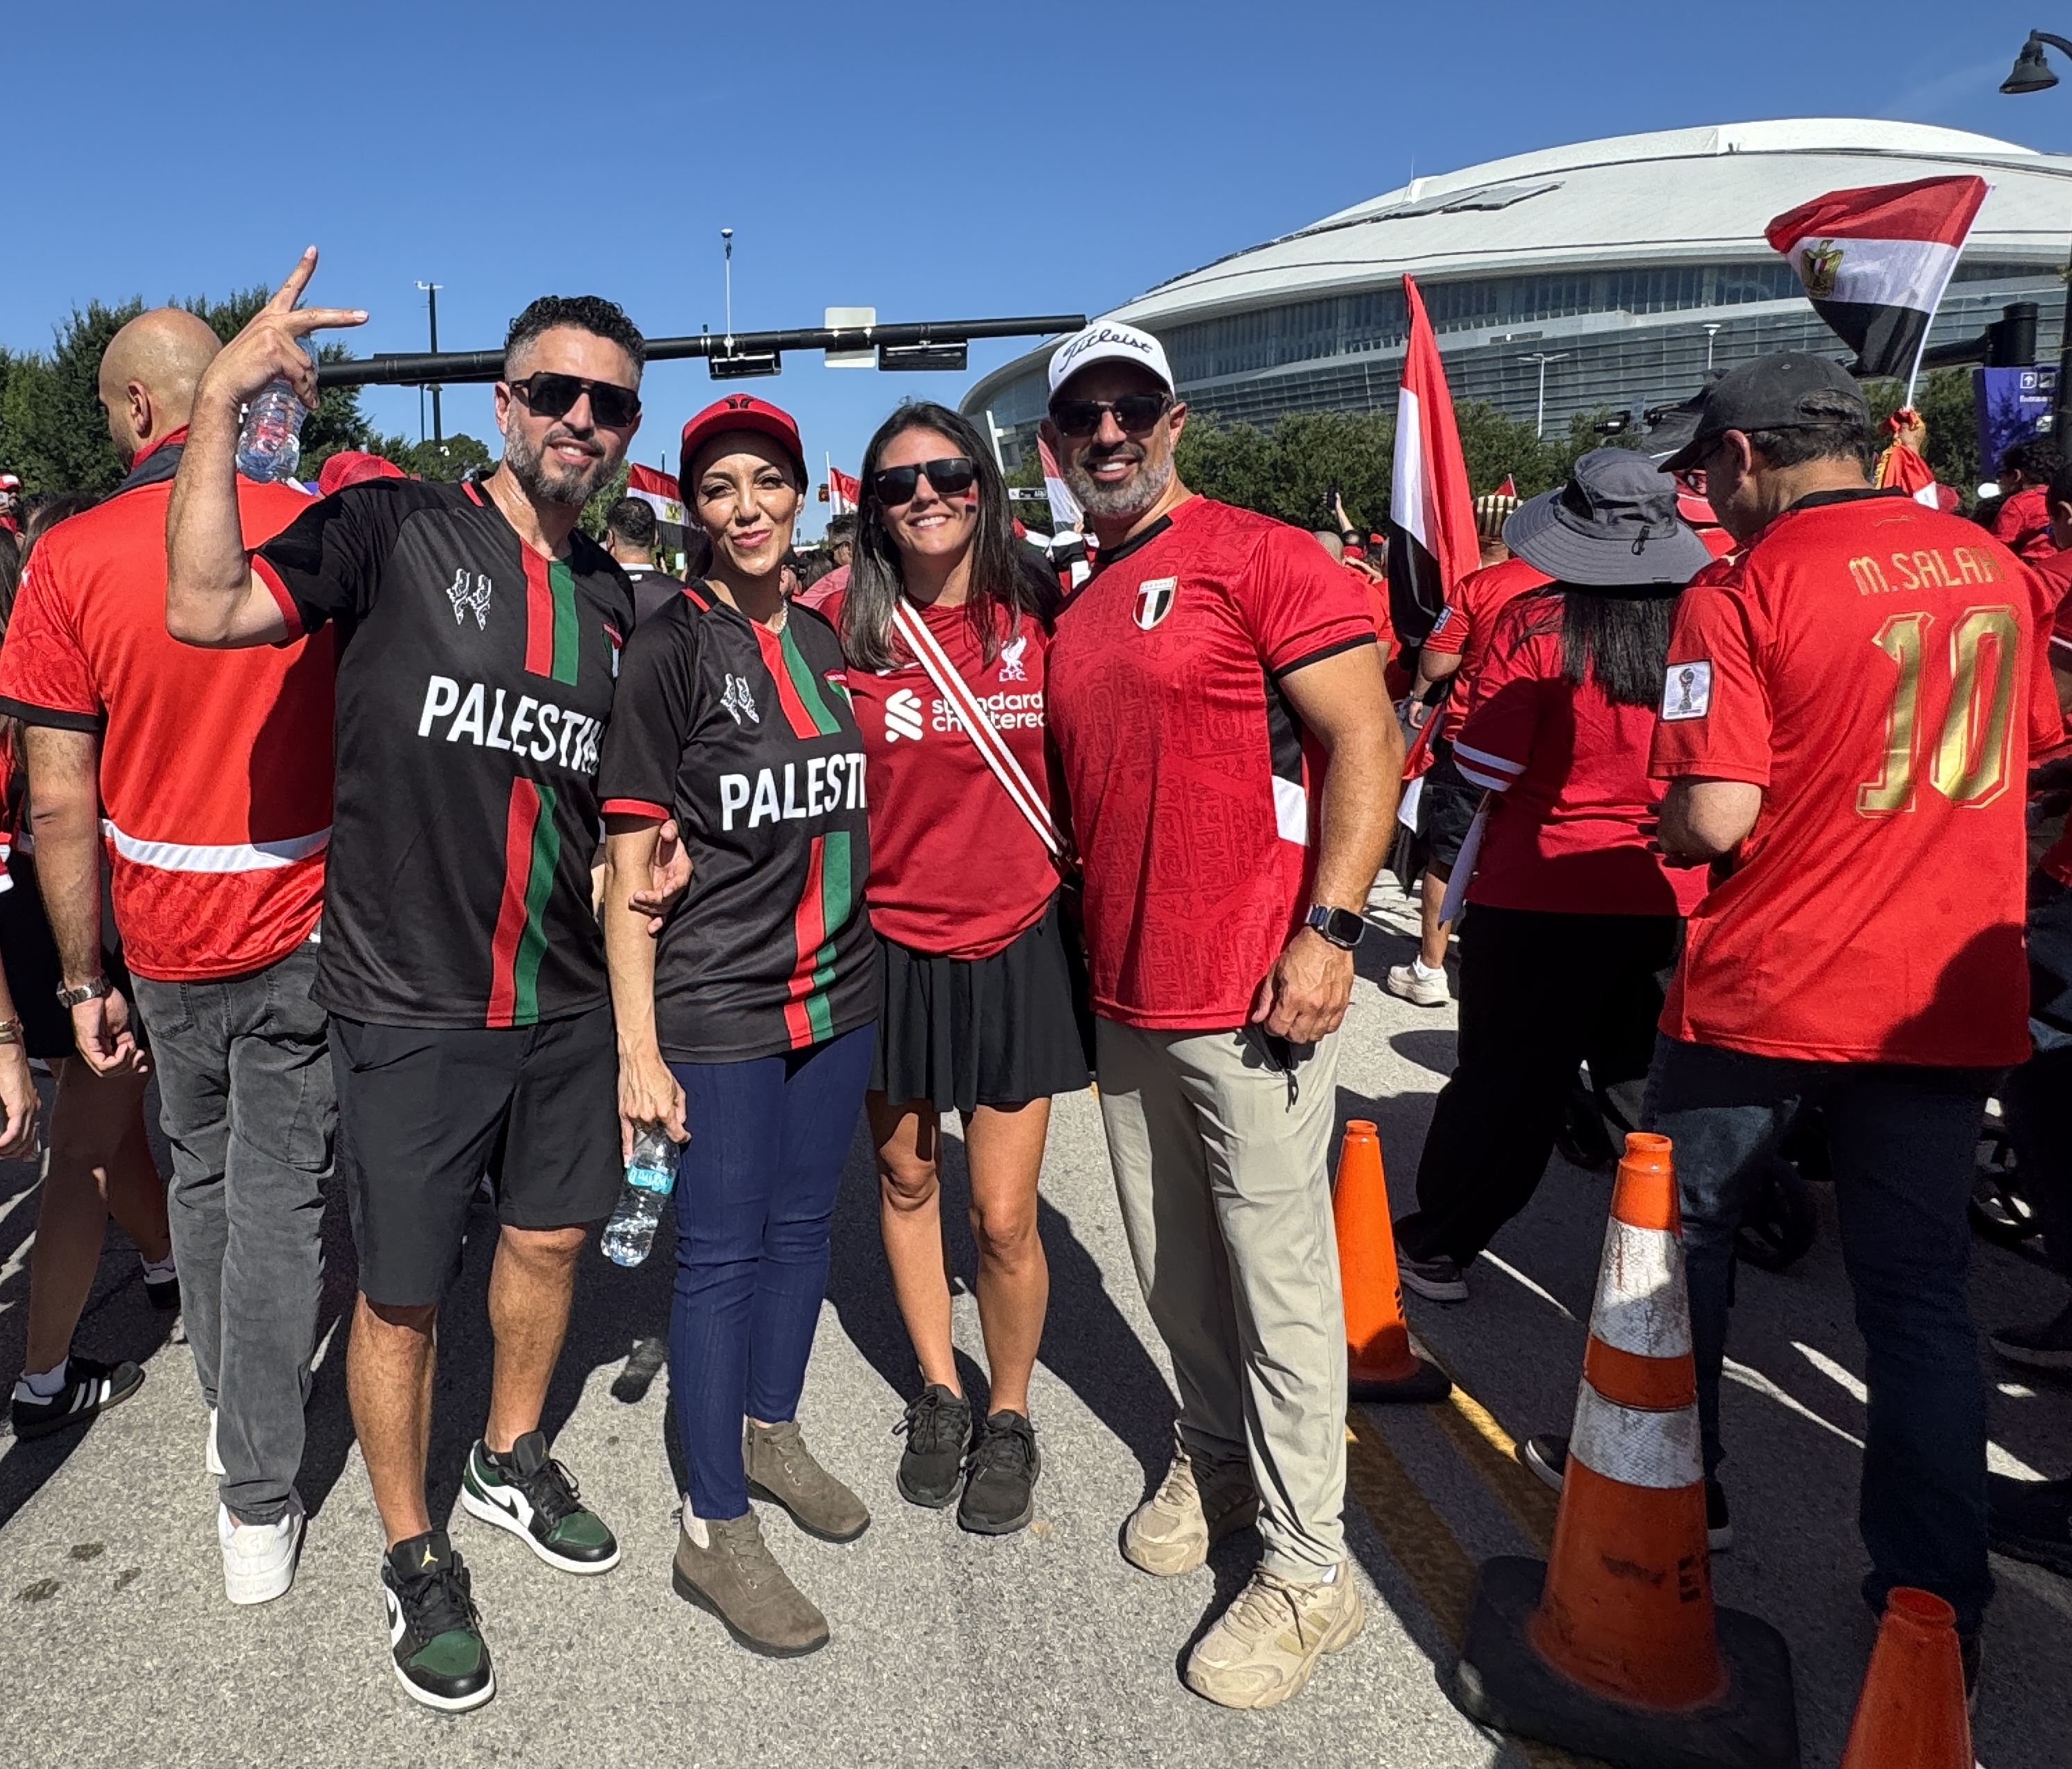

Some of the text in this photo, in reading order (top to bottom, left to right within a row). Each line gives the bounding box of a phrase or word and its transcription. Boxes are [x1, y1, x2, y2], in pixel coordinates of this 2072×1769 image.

[1059, 328, 1153, 373] Titleist
[1848, 546, 2006, 595] M.SALAH
[999, 670, 1028, 682] LFC
[932, 690, 1044, 714] stndard
[1856, 604, 2021, 817] 10
